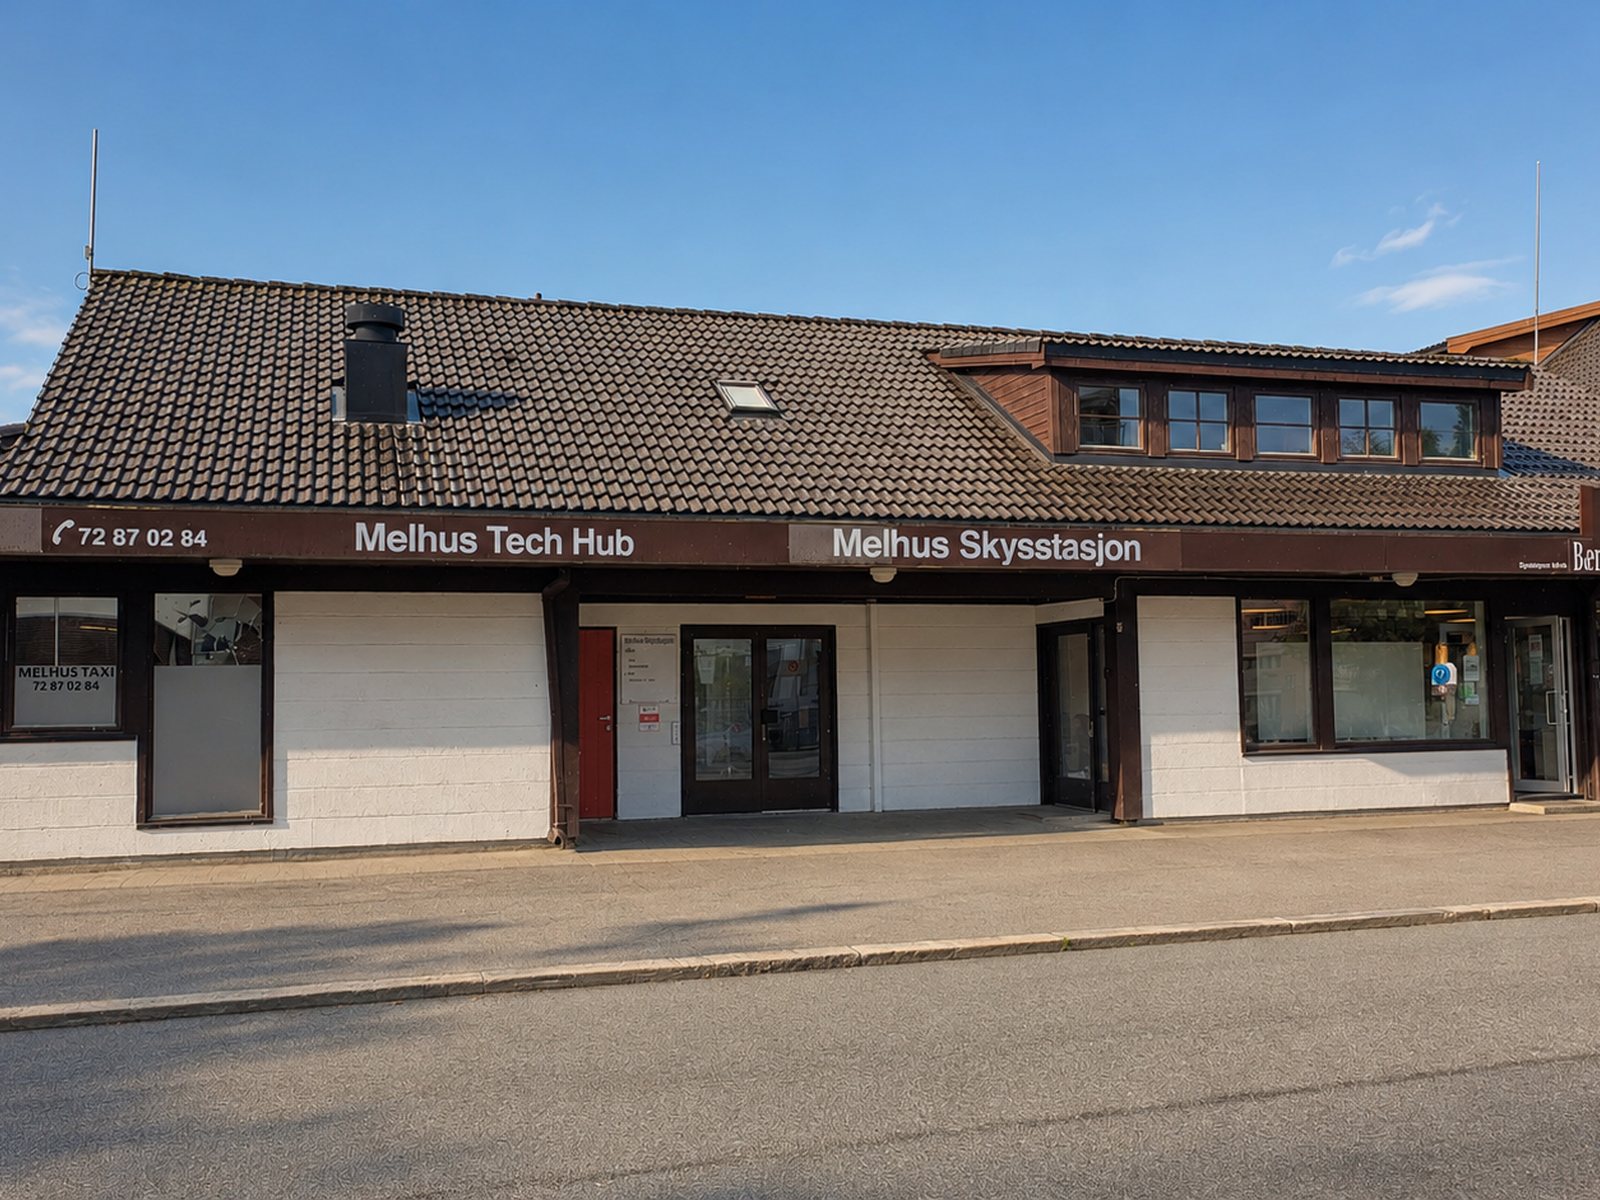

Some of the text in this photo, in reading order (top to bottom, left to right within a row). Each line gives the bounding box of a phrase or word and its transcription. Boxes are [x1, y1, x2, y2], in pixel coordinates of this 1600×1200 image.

[78, 527, 208, 547] 72 87 02 84
[355, 522, 635, 557] Melhus Tech Hub
[833, 528, 1142, 566] Melhus Skysstasjon
[18, 666, 115, 678] MELHUS TAXI
[33, 681, 100, 692] 72 87 02 84
